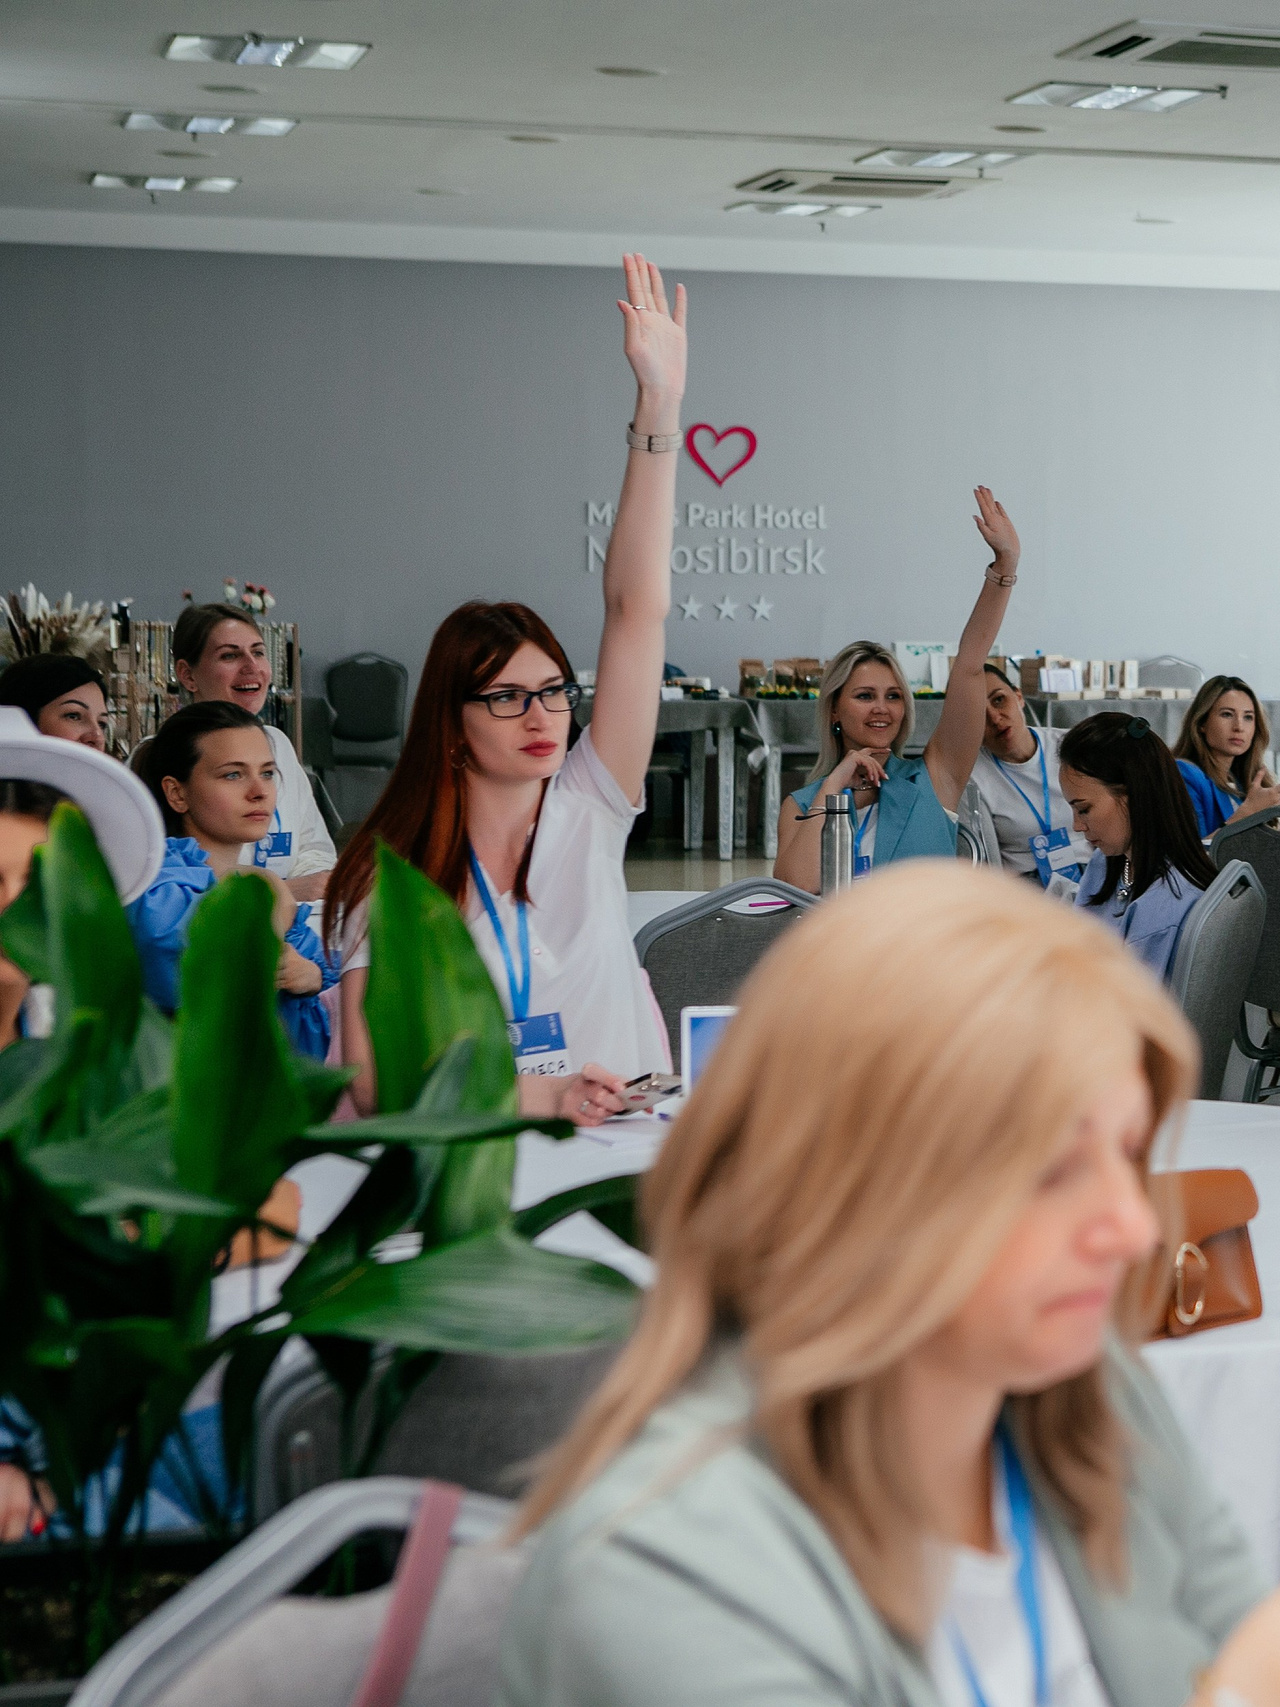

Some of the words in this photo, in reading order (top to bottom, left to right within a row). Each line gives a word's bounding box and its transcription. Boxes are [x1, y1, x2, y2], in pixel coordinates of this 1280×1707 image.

[687, 502, 747, 529] Park
[753, 504, 827, 530] Hotel
[586, 535, 826, 576] Nosibirsk
